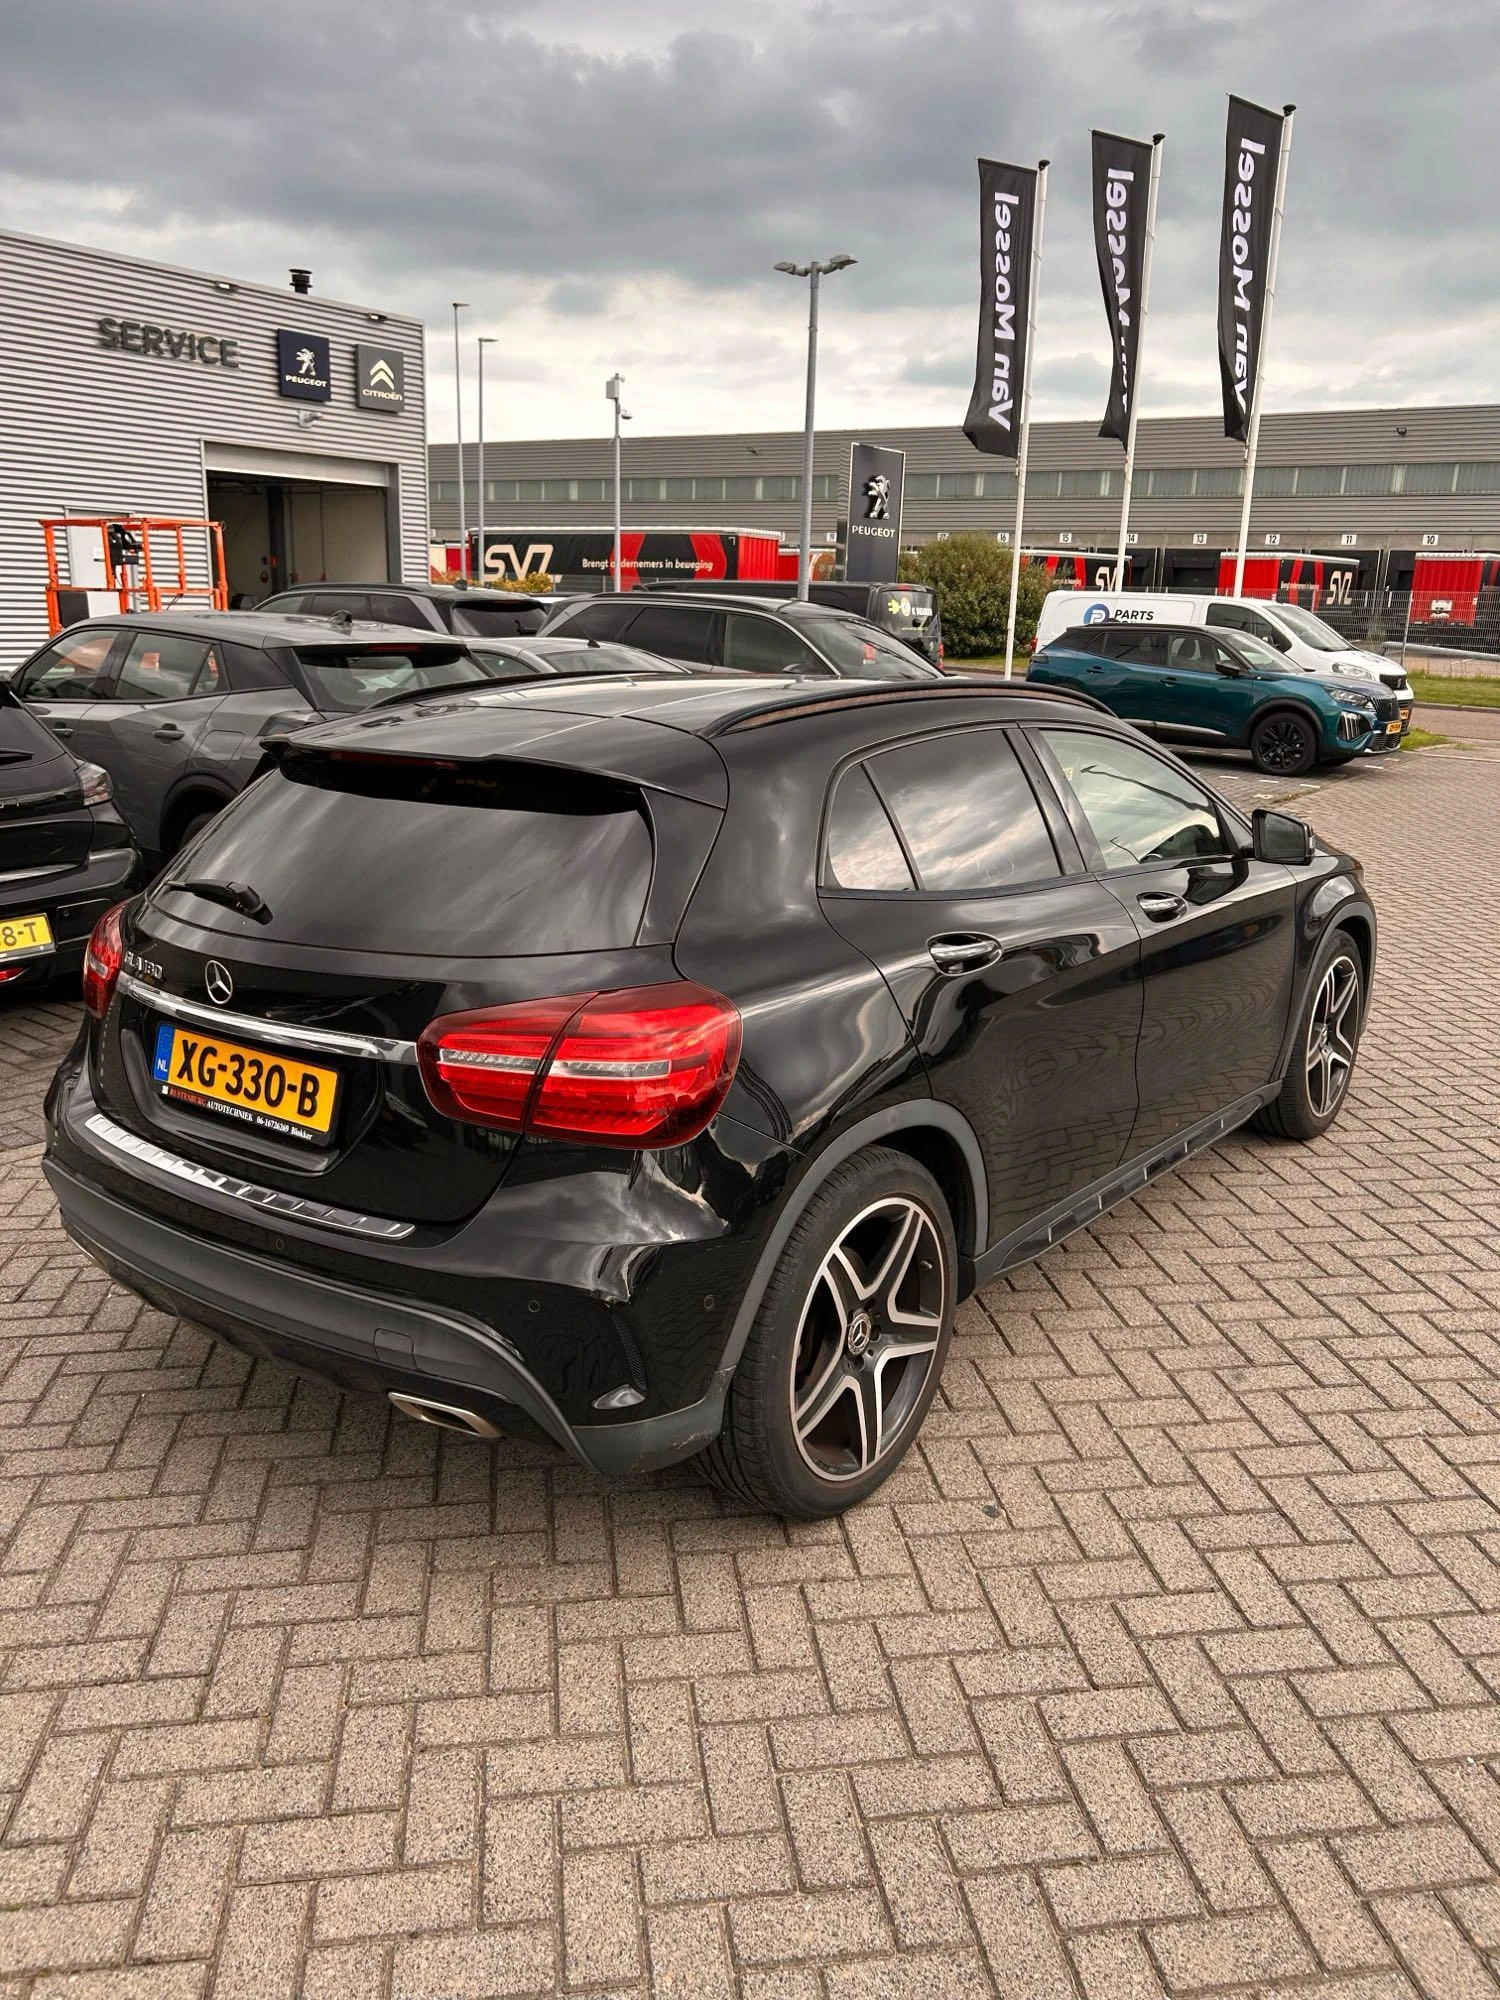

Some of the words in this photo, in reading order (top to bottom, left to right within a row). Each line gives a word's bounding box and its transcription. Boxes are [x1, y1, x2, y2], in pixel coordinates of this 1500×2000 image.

[98, 316, 240, 369] SERVICE
[285, 374, 328, 388] PEUGEOT
[851, 525, 896, 539] PEUGEOT
[582, 558, 608, 571] Brengt
[610, 558, 663, 569] odernemers
[665, 559, 673, 569] in
[675, 558, 714, 571] beweging
[1326, 570, 1353, 605] SVZ
[1114, 609, 1154, 621] PARTS
[157, 1057, 168, 1073] NL
[176, 1039, 321, 1119] XG-330-B
[206, 1100, 254, 1122] AUTOTECHNIEK
